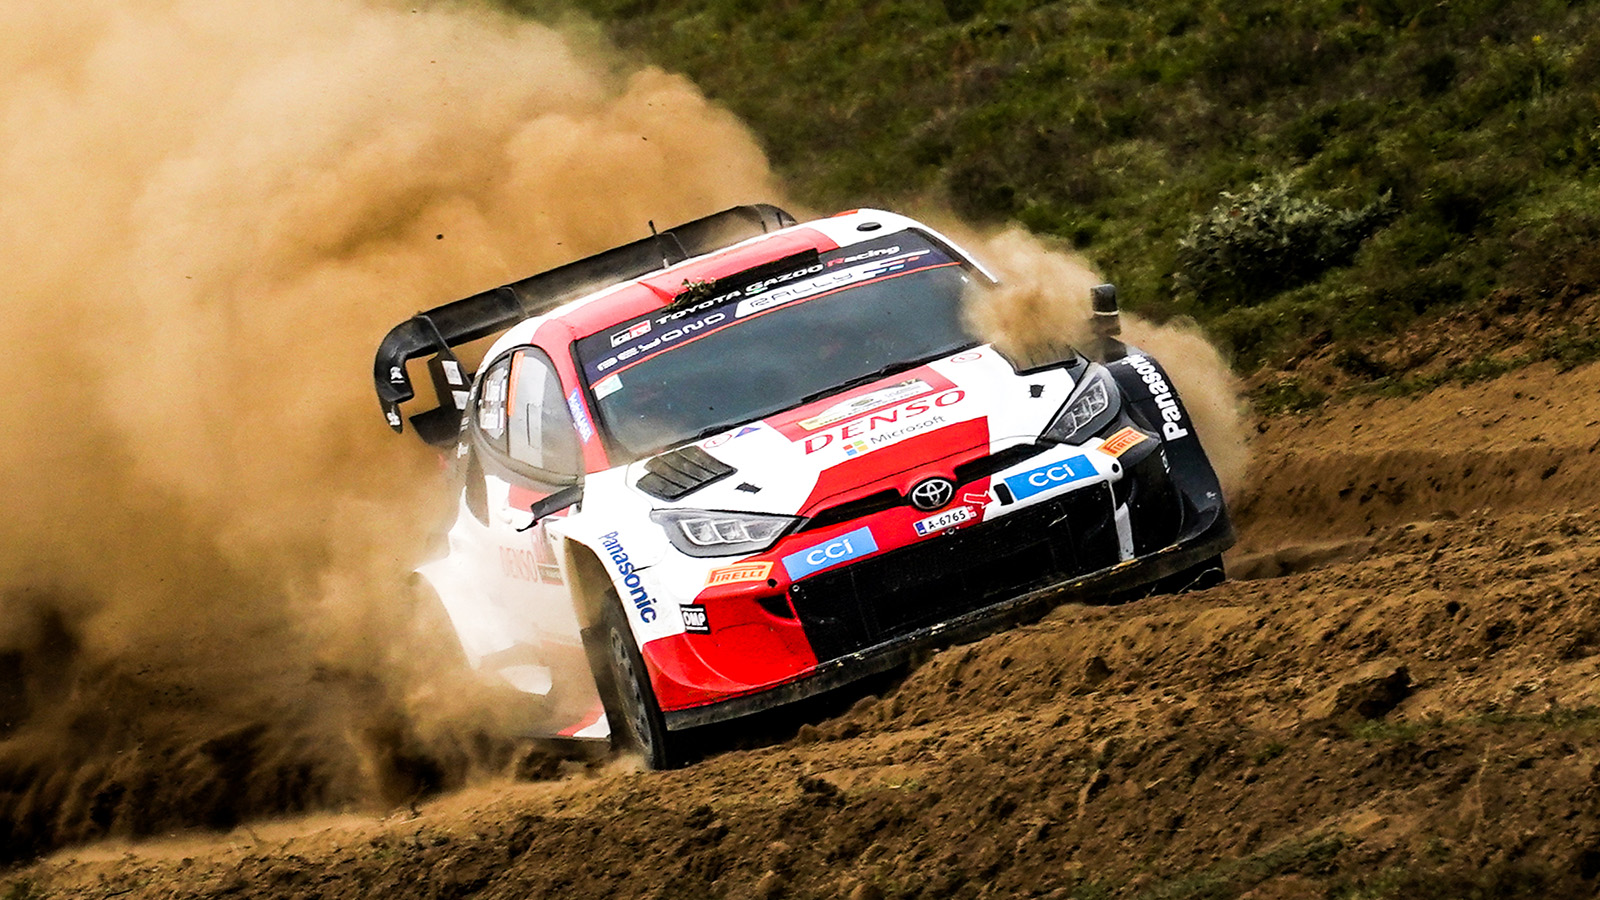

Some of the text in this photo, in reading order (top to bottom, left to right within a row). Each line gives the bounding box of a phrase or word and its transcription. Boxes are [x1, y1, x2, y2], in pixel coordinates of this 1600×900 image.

[613, 244, 900, 346] GR TOYOTA GAZOO Racing
[597, 271, 853, 372] BEYOND RALLY
[804, 389, 965, 455] DENSO
[870, 415, 946, 445] Microsoft
[1102, 429, 1142, 456] PIRELLI
[928, 509, 966, 531] A-6765
[599, 530, 657, 623] Panasonic
[708, 563, 772, 585] PIRELLI
[683, 611, 706, 628] OMP
